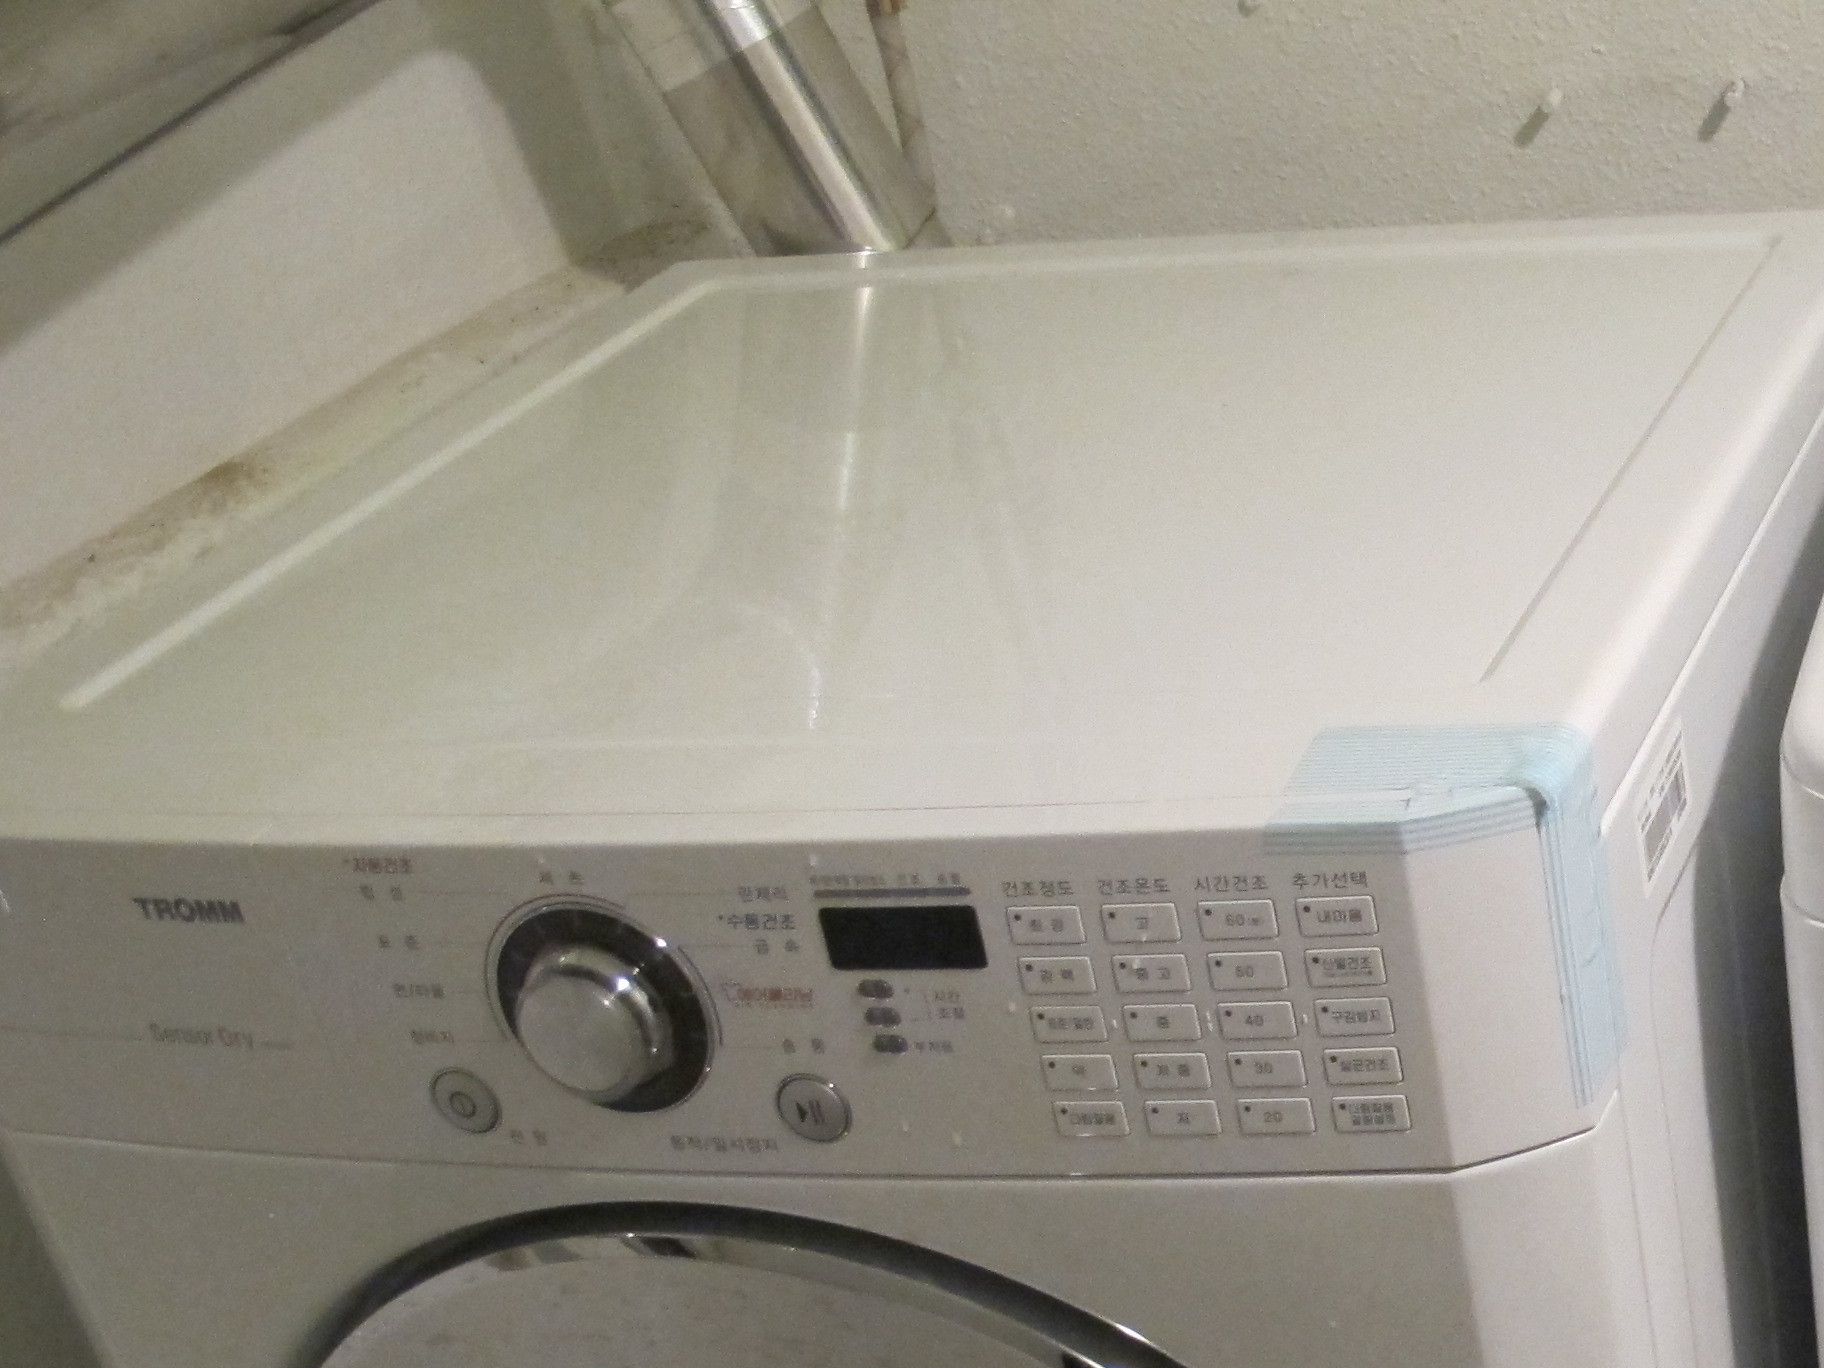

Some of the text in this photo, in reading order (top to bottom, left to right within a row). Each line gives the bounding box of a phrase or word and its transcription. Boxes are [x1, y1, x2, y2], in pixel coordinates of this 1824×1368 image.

[1194, 875, 1268, 892] 시간건조
[1292, 872, 1368, 890] 추가선택
[132, 897, 245, 924] TROMM
